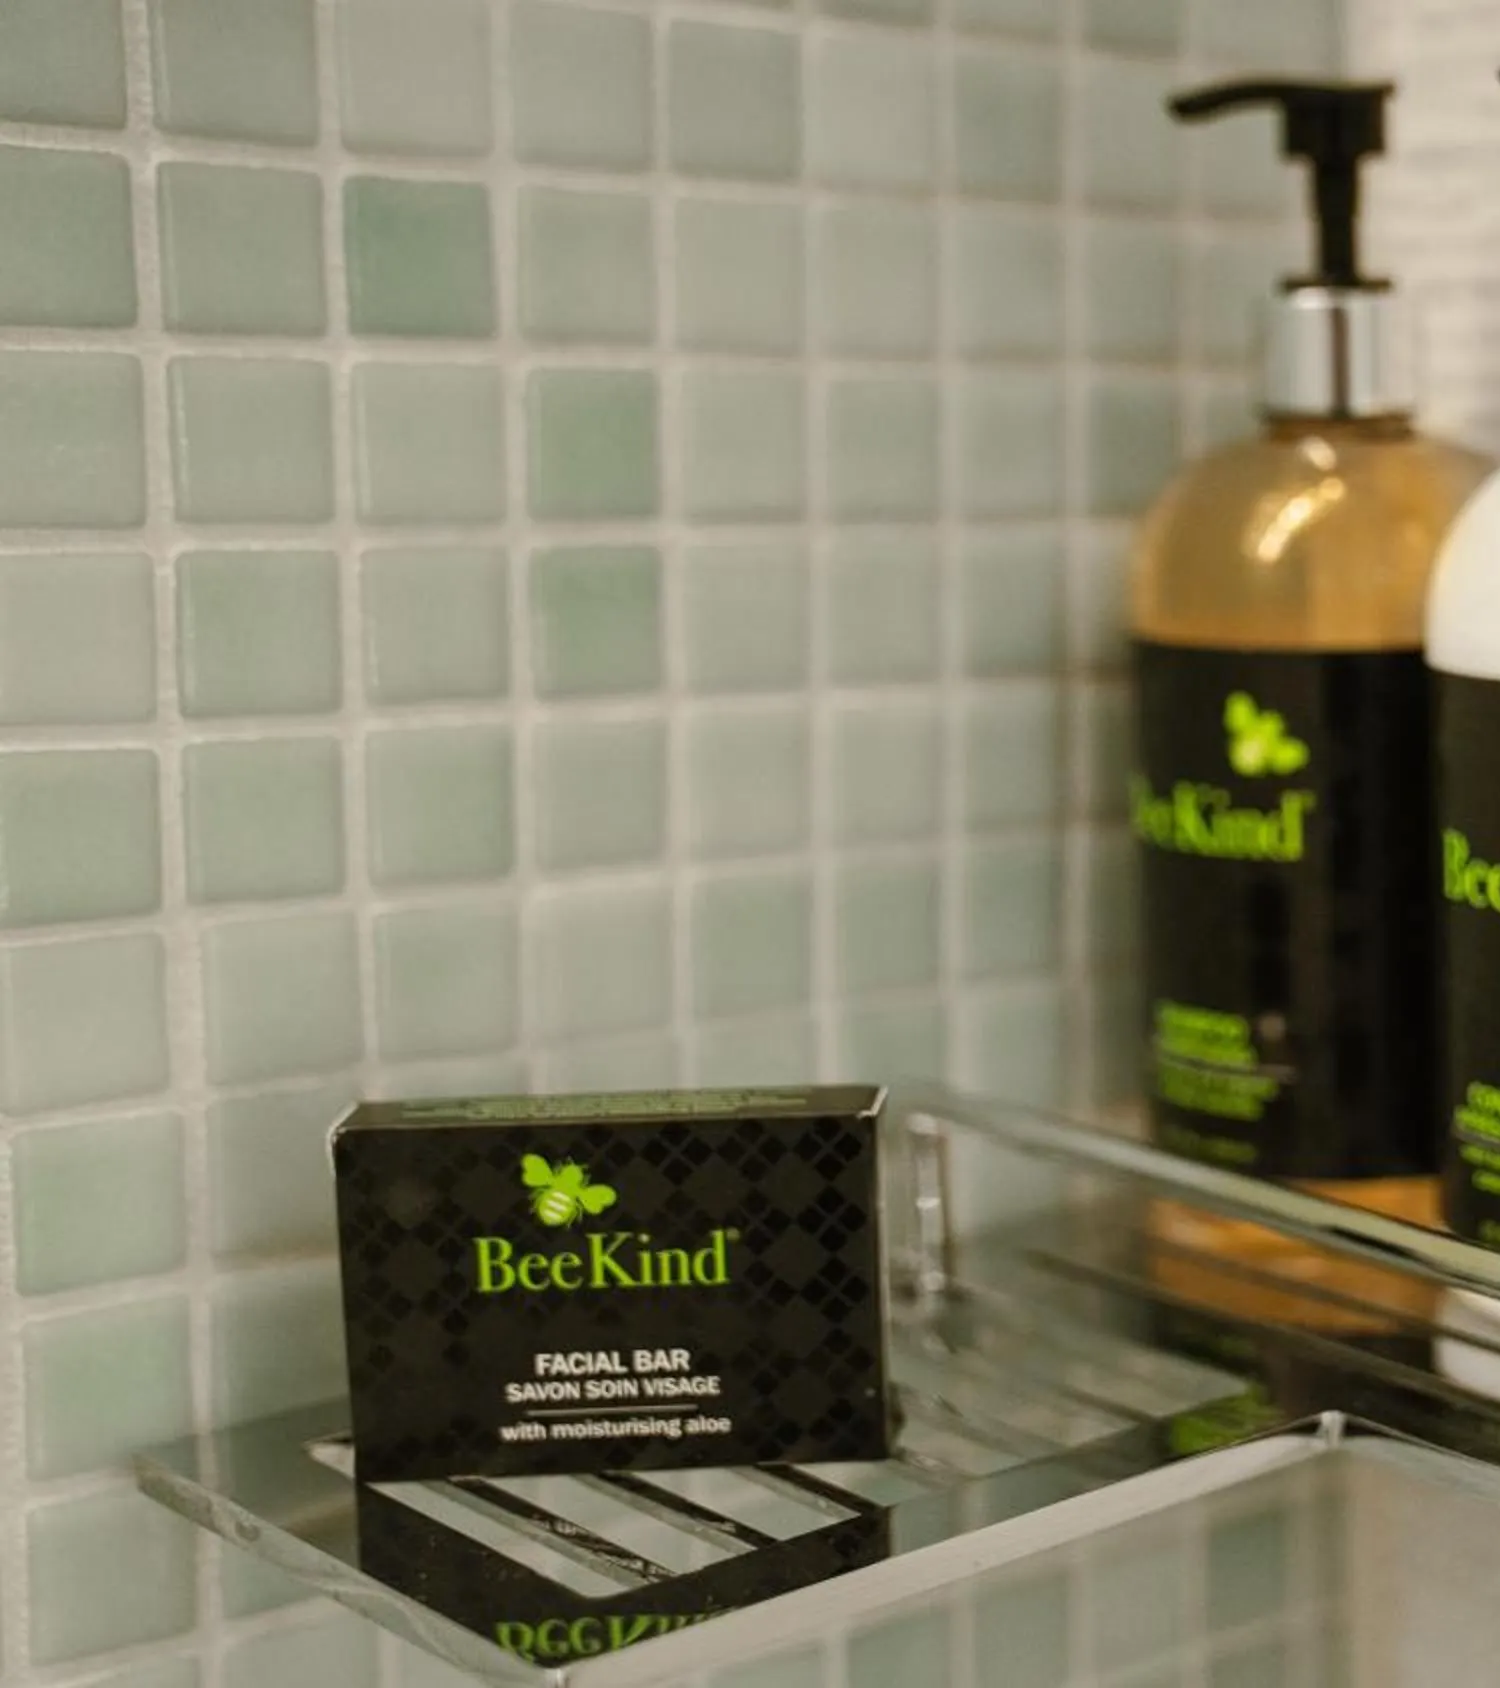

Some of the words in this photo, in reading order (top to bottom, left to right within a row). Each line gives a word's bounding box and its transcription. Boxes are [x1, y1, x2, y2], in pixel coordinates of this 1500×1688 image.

[534, 1351, 629, 1377] FACIAL
[633, 1348, 691, 1373] BAR
[504, 1380, 581, 1403] SAVON
[584, 1377, 639, 1400] SOIN
[642, 1375, 722, 1397] VISAGE
[500, 1420, 547, 1441] with
[549, 1416, 682, 1439] moisturising
[684, 1414, 733, 1434] aloe
